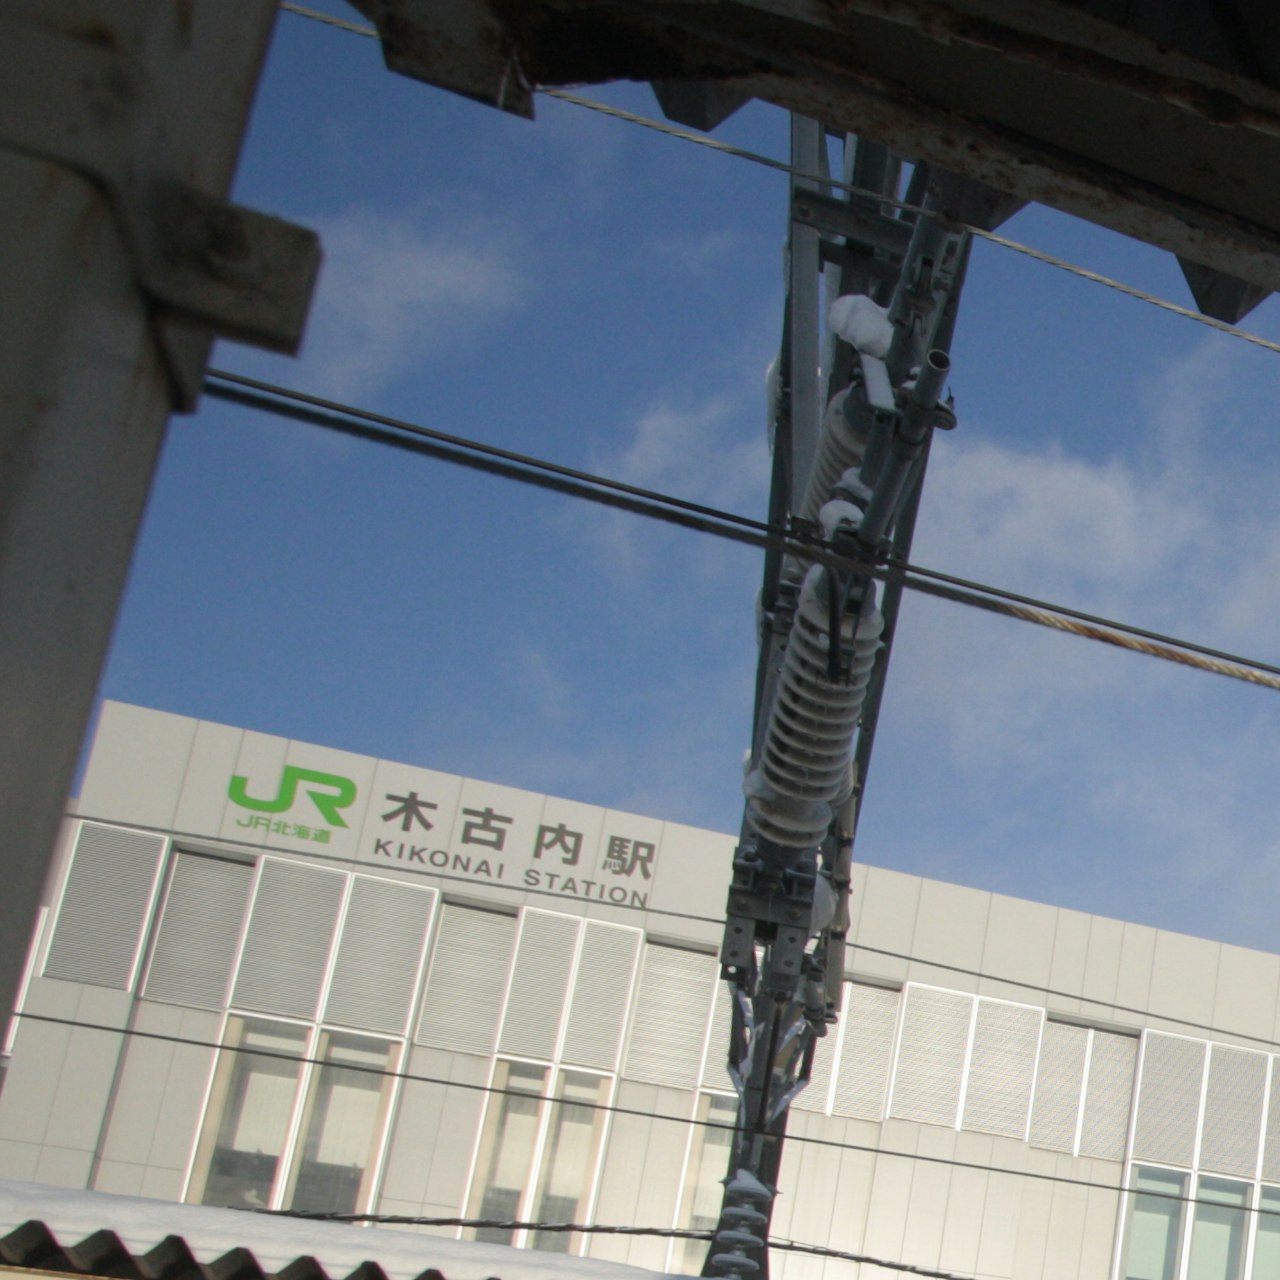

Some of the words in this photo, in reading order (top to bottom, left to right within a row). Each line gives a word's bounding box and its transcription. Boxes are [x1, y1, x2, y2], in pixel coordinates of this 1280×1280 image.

[228, 765, 358, 829] JR
[236, 815, 332, 845] JR北海道
[381, 791, 658, 882] 木古内駅
[373, 837, 504, 880] KIKONAI
[523, 868, 649, 909] STATION
